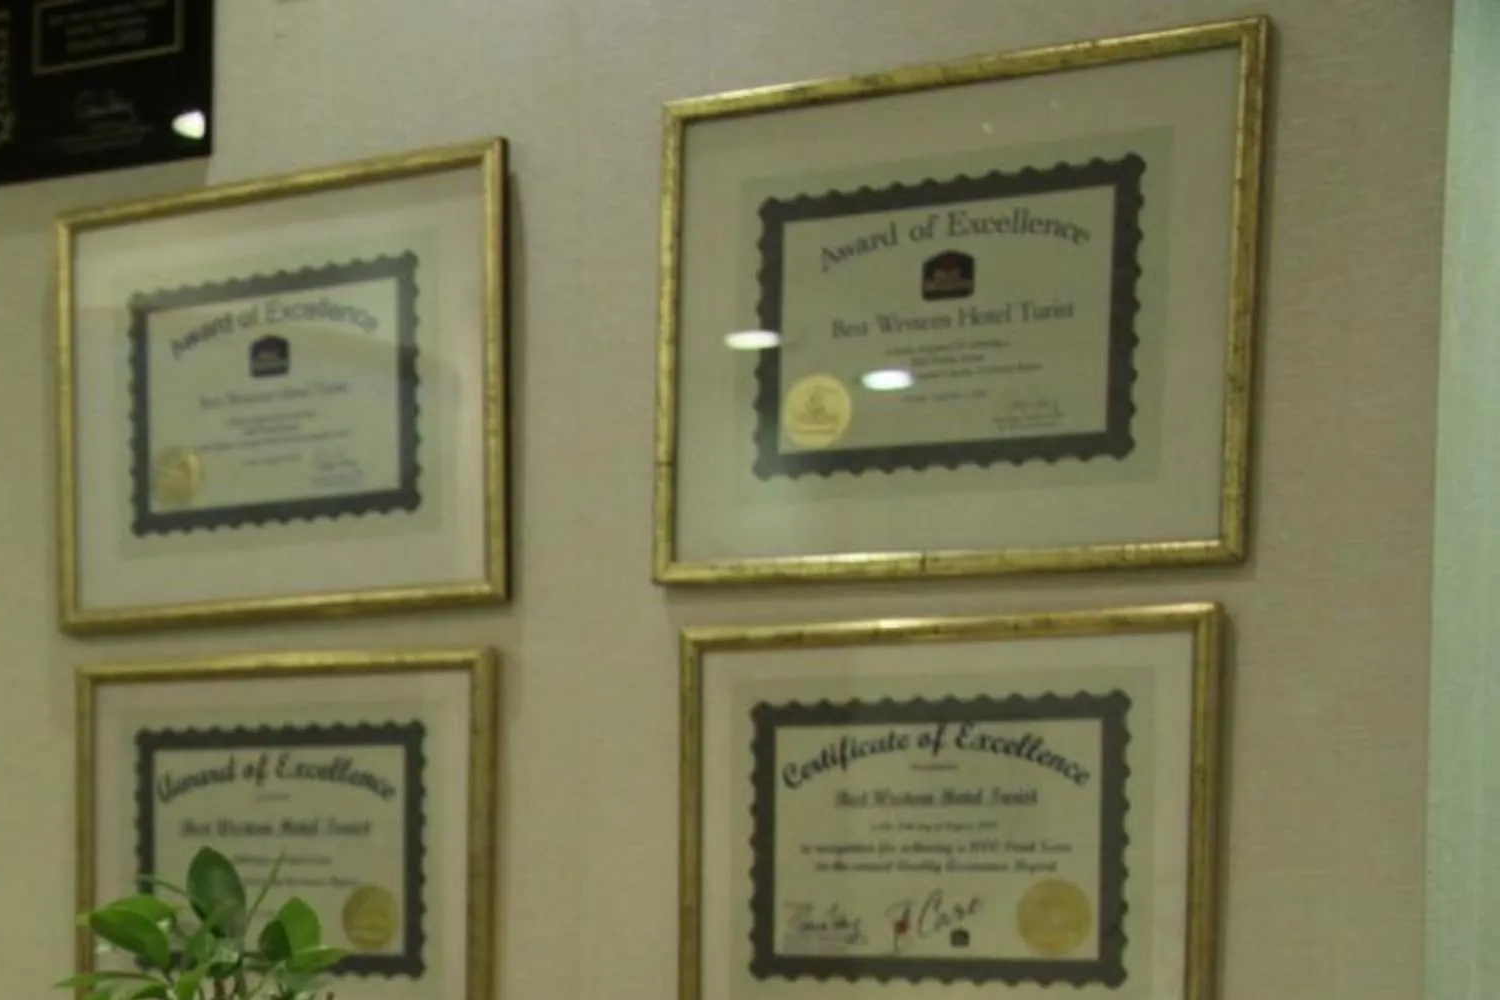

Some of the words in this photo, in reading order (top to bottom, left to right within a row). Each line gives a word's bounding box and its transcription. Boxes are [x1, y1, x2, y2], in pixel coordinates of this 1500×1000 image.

[820, 221, 899, 273] Award
[909, 213, 939, 243] of
[947, 207, 1091, 246] Excellence
[266, 297, 378, 334] Excellence
[831, 317, 868, 339] Best
[875, 312, 952, 337] Western
[957, 304, 1013, 328] Hotel
[242, 752, 268, 788] of
[275, 752, 396, 800] Excellence
[781, 728, 910, 790] Certificate
[917, 722, 948, 757] of
[954, 721, 1092, 788] Excellence
